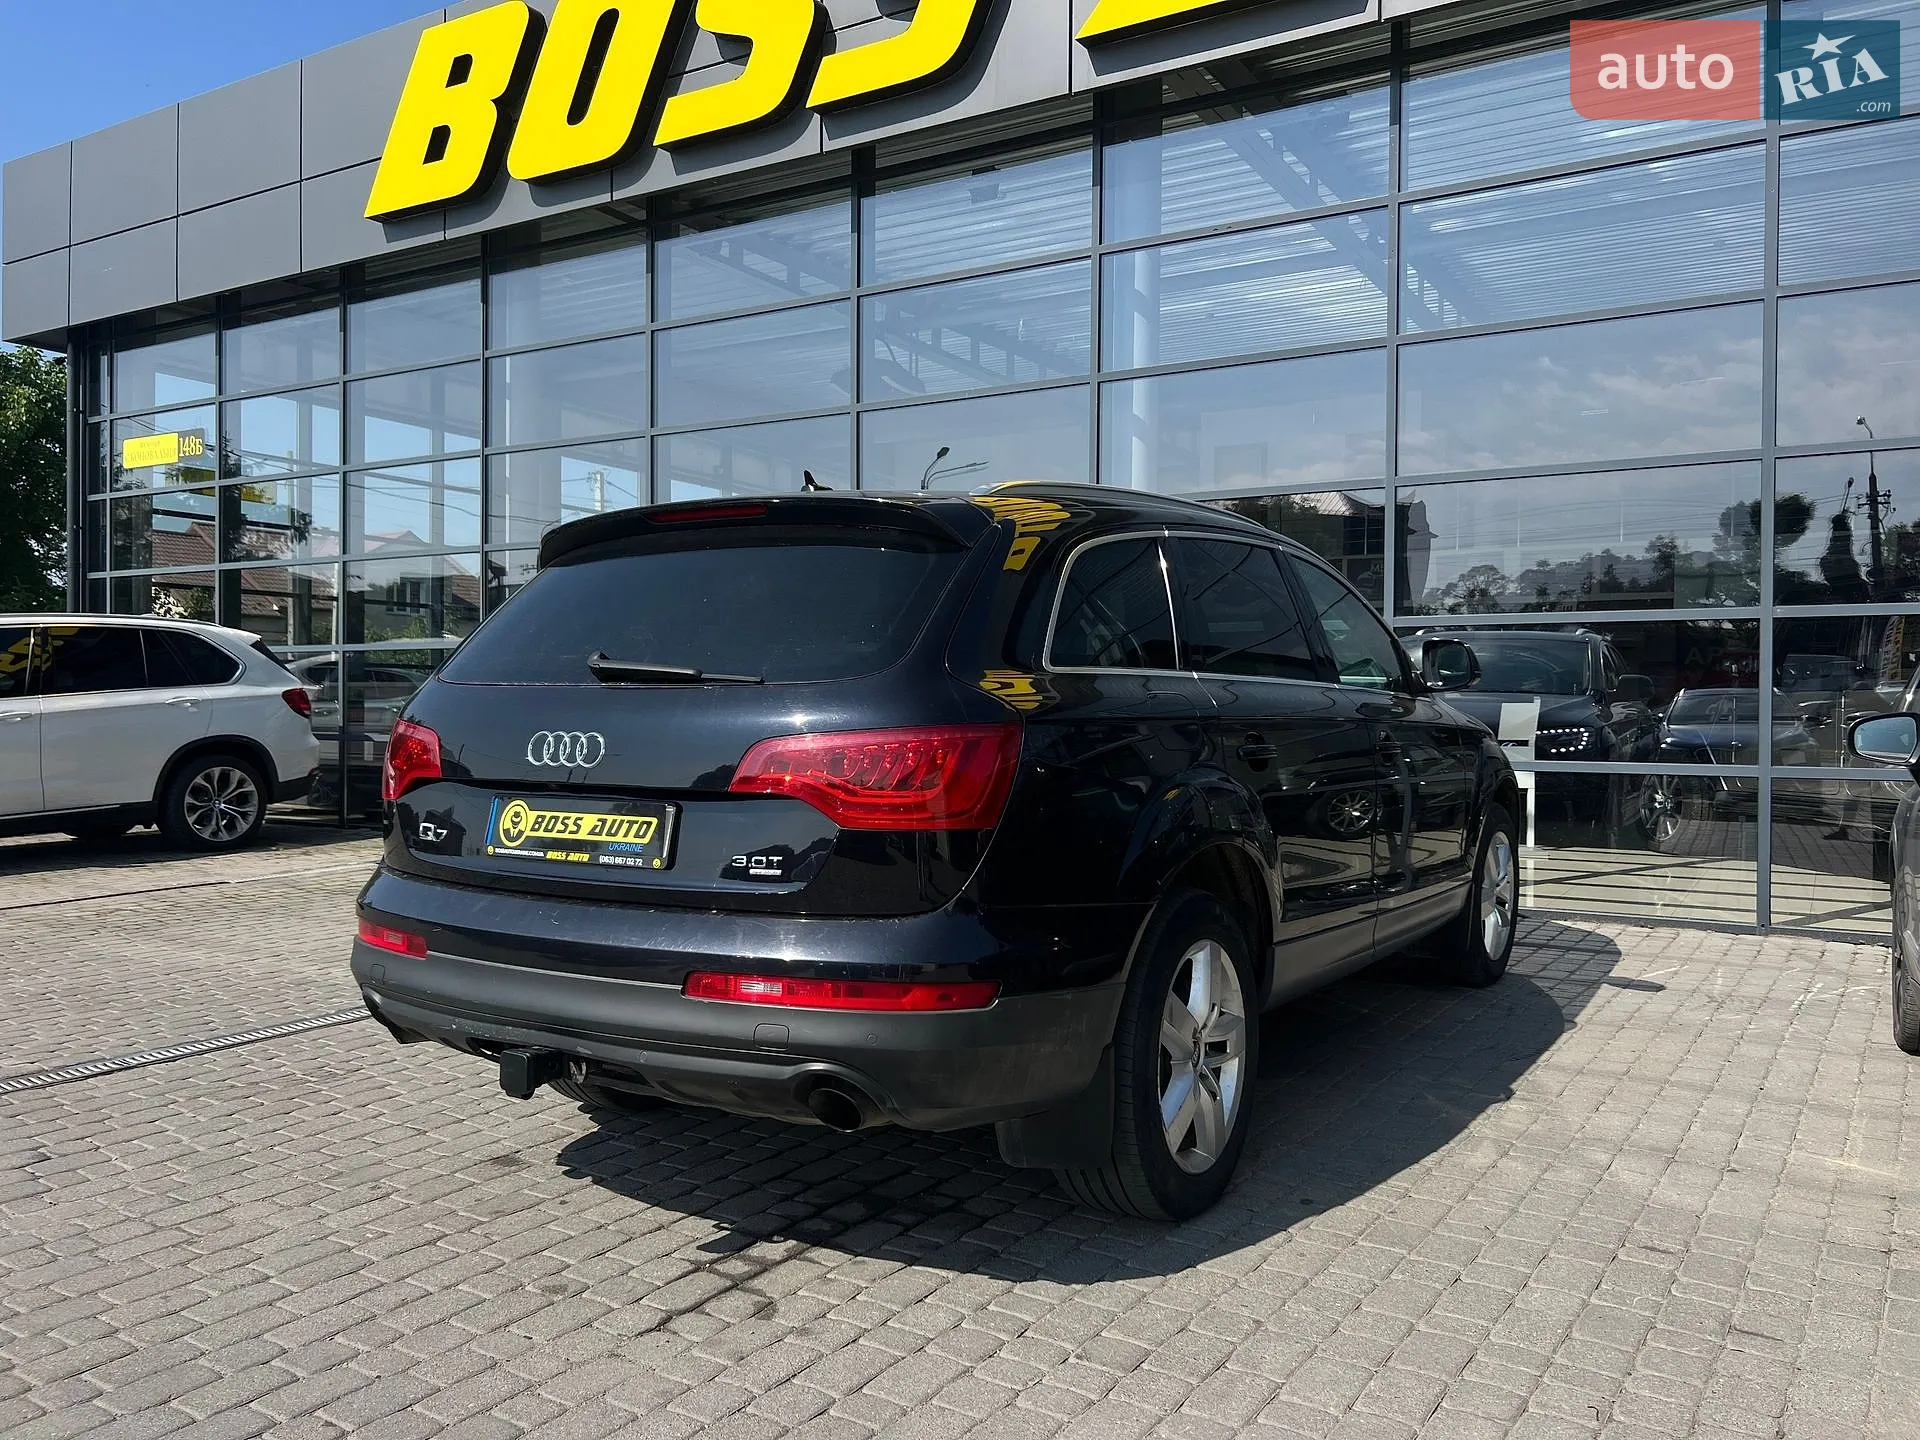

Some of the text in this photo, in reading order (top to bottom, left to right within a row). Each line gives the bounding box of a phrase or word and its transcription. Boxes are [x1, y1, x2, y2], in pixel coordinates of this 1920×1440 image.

[178, 435, 204, 457] 148Б
[419, 822, 448, 842] Q7
[530, 814, 653, 839] BOSS AUTO
[545, 850, 567, 860] BOSS
[566, 852, 591, 862] AUTO
[608, 843, 645, 853] UKRAINE
[731, 855, 783, 868] 3.0T
